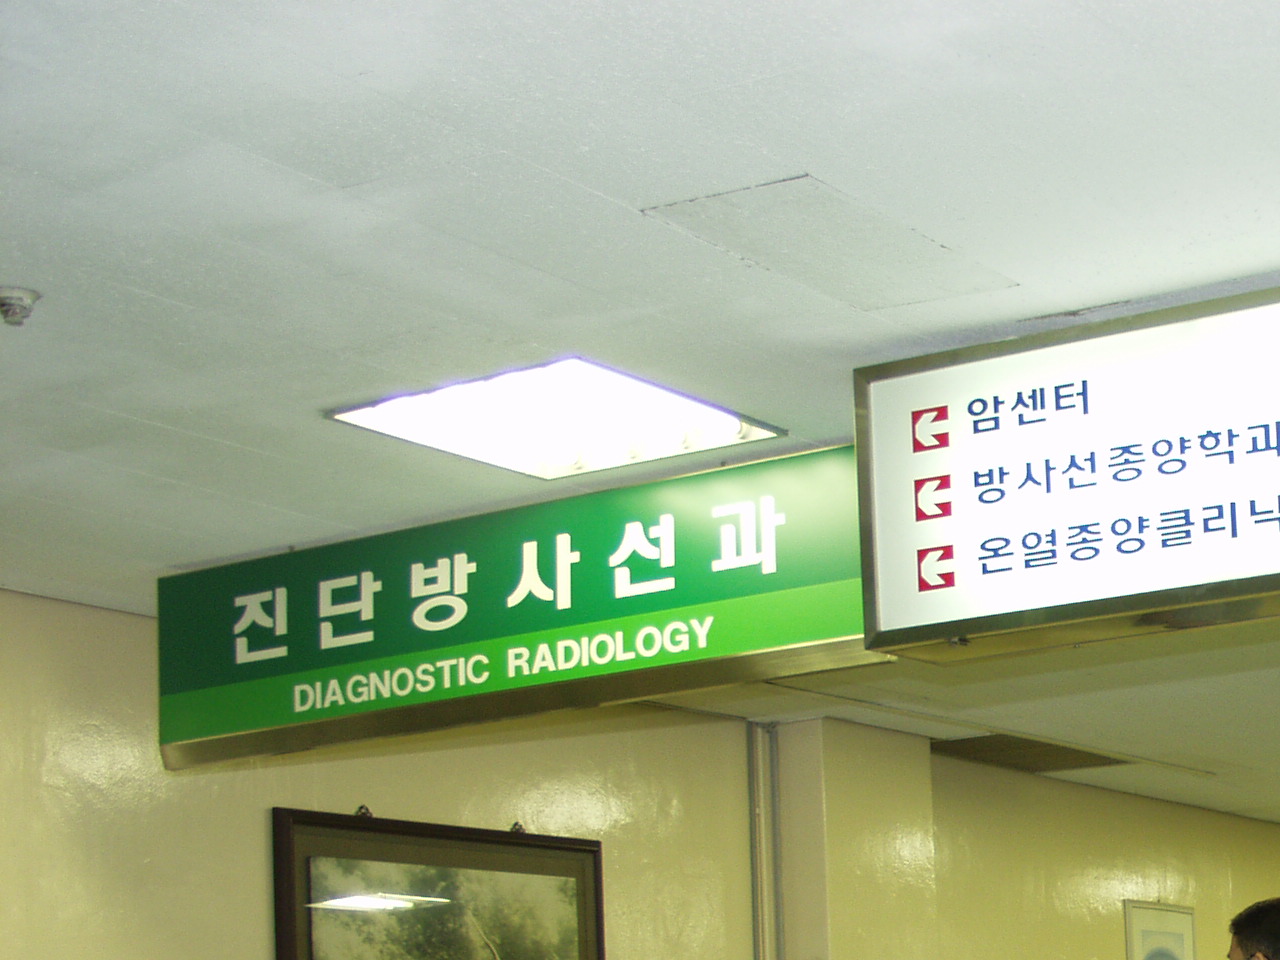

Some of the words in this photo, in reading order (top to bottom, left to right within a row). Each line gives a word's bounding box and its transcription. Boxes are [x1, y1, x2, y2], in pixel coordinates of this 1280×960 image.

[967, 379, 1089, 433] 암센터
[232, 494, 787, 666] 진단방사선과
[292, 653, 491, 714] DIAGNOSTIC
[506, 615, 716, 679] RADIOLOGY
